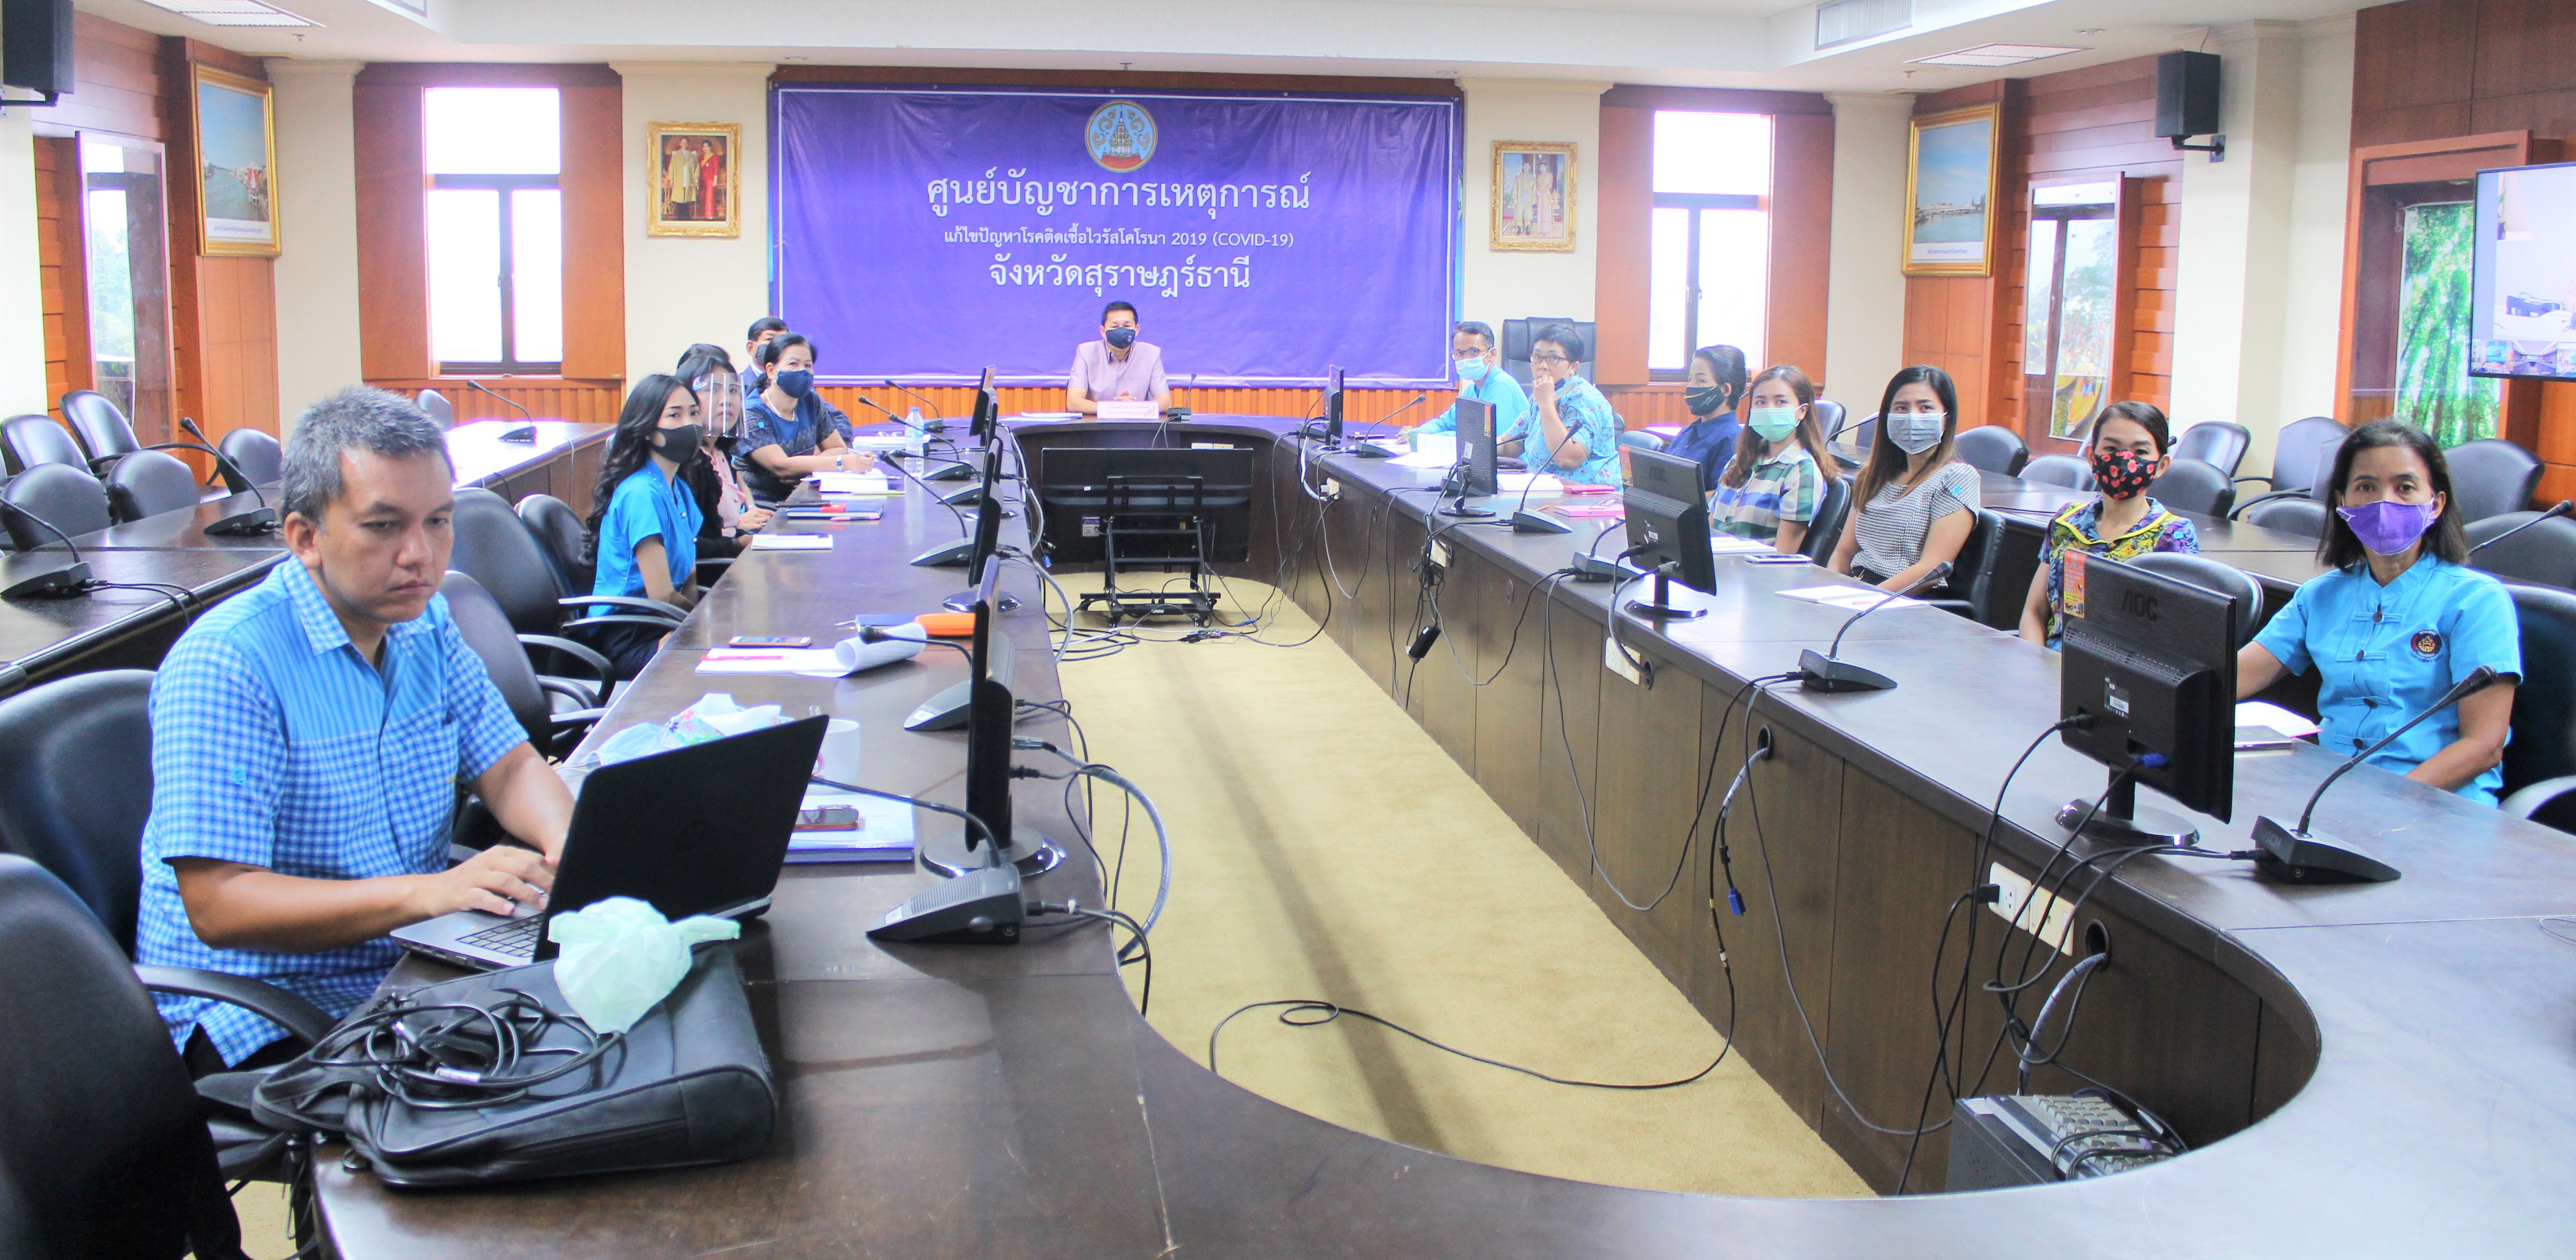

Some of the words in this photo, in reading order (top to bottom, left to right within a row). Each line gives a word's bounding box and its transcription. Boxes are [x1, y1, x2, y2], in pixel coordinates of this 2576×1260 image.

[927, 166, 1311, 220] ศูนย์บัญชาการเหตุการณ์
[944, 223, 1166, 248] แก้ไขปัญหาโรคติดเชื้อไวรัสโคโรนา
[1171, 232, 1207, 245] 2019
[1212, 231, 1294, 248] (COVID-19)
[989, 252, 1250, 298] จังหวัดสุราษฎร์ธานี
[2122, 589, 2158, 622] AOC
